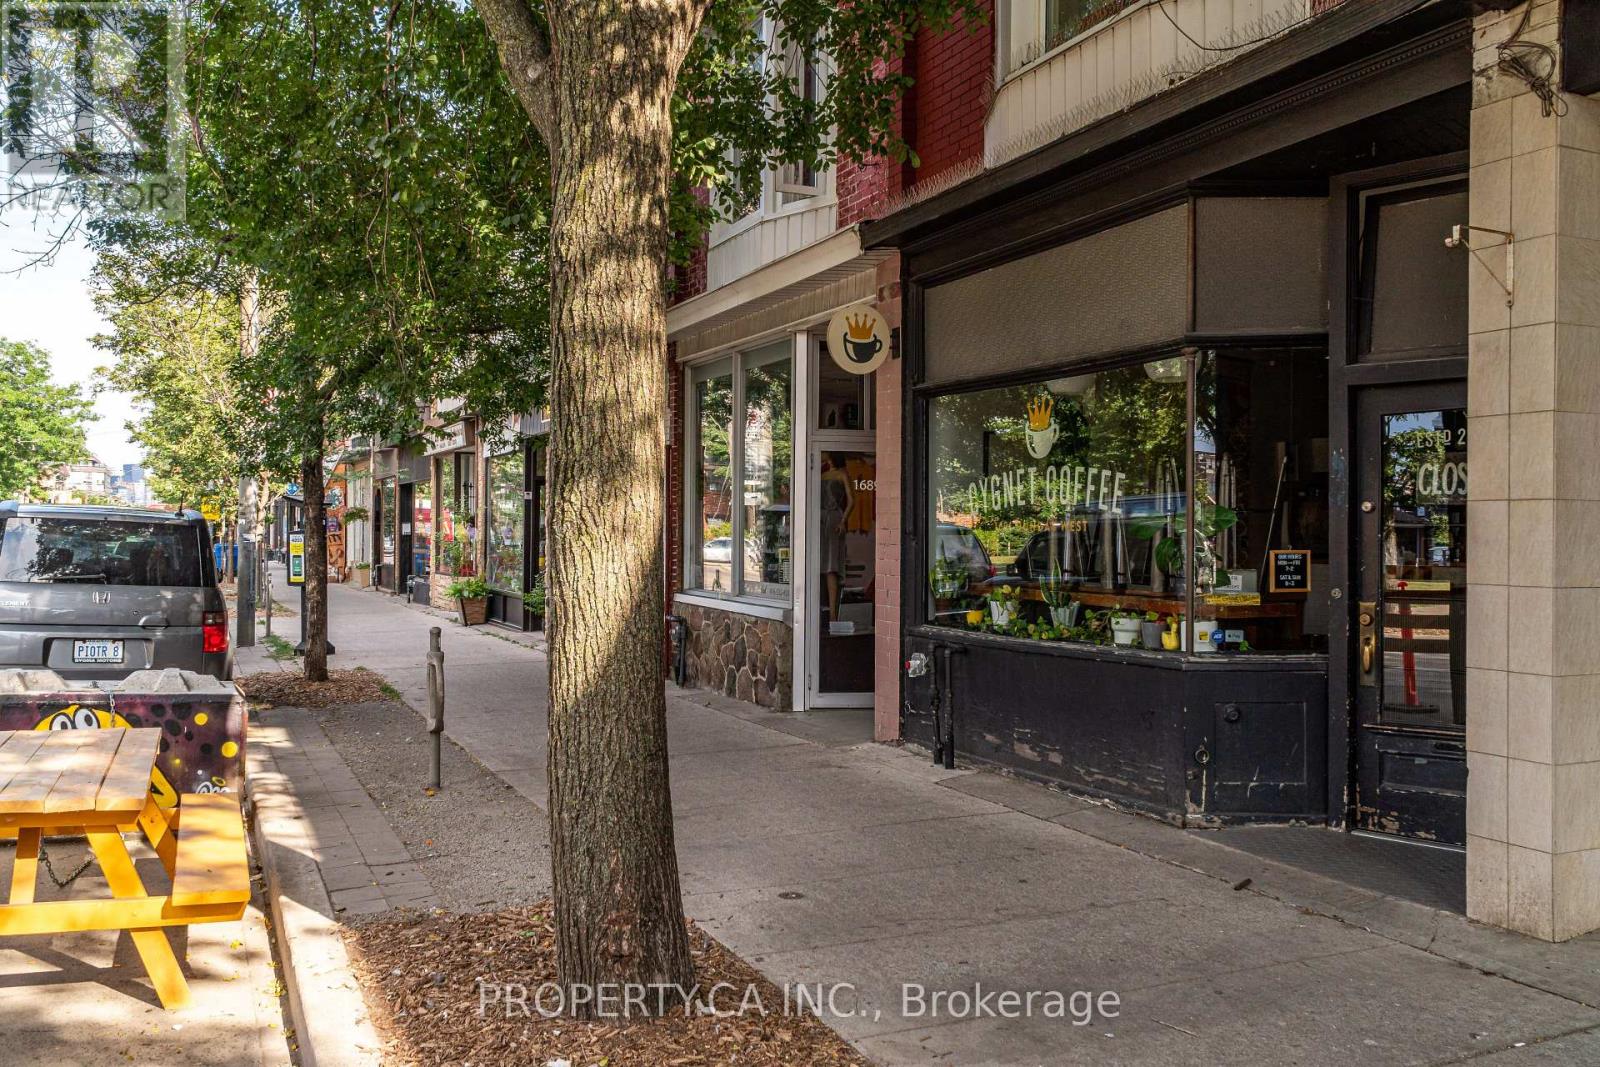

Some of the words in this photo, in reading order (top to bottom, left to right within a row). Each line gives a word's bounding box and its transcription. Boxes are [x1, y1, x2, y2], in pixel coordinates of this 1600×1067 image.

[968, 467, 1038, 516] CYGNET
[1045, 464, 1127, 515] COFFEE
[1418, 462, 1468, 496] CLOS
[77, 645, 108, 657] PIOTR
[113, 645, 119, 657] 8
